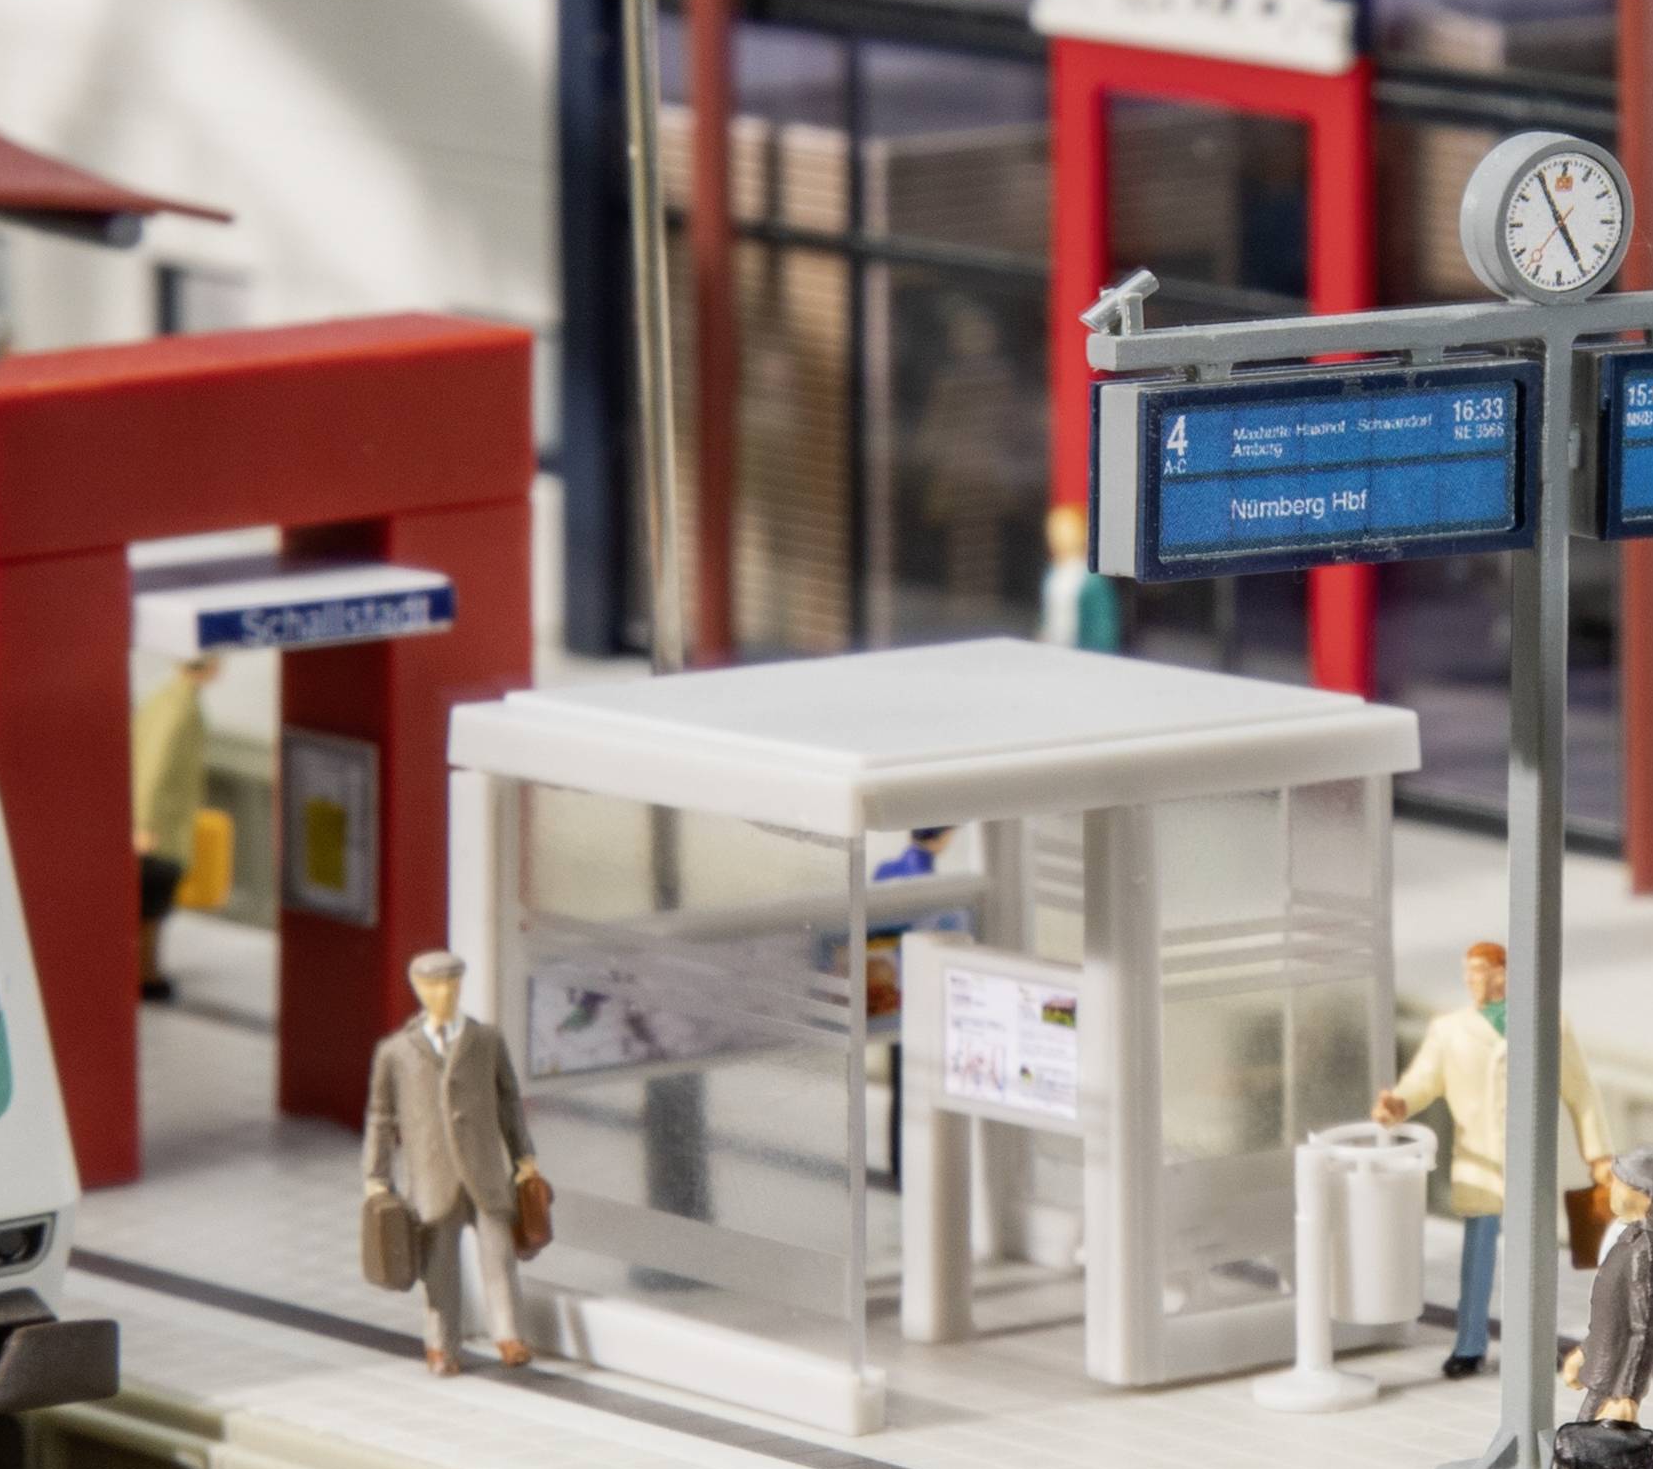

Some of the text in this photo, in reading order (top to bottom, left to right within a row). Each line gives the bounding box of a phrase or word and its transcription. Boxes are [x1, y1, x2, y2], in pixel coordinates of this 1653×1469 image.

[1452, 397, 1504, 422] 16:33
[1166, 415, 1189, 456] 4
[1230, 488, 1368, 521] Nürnberg Hbf
